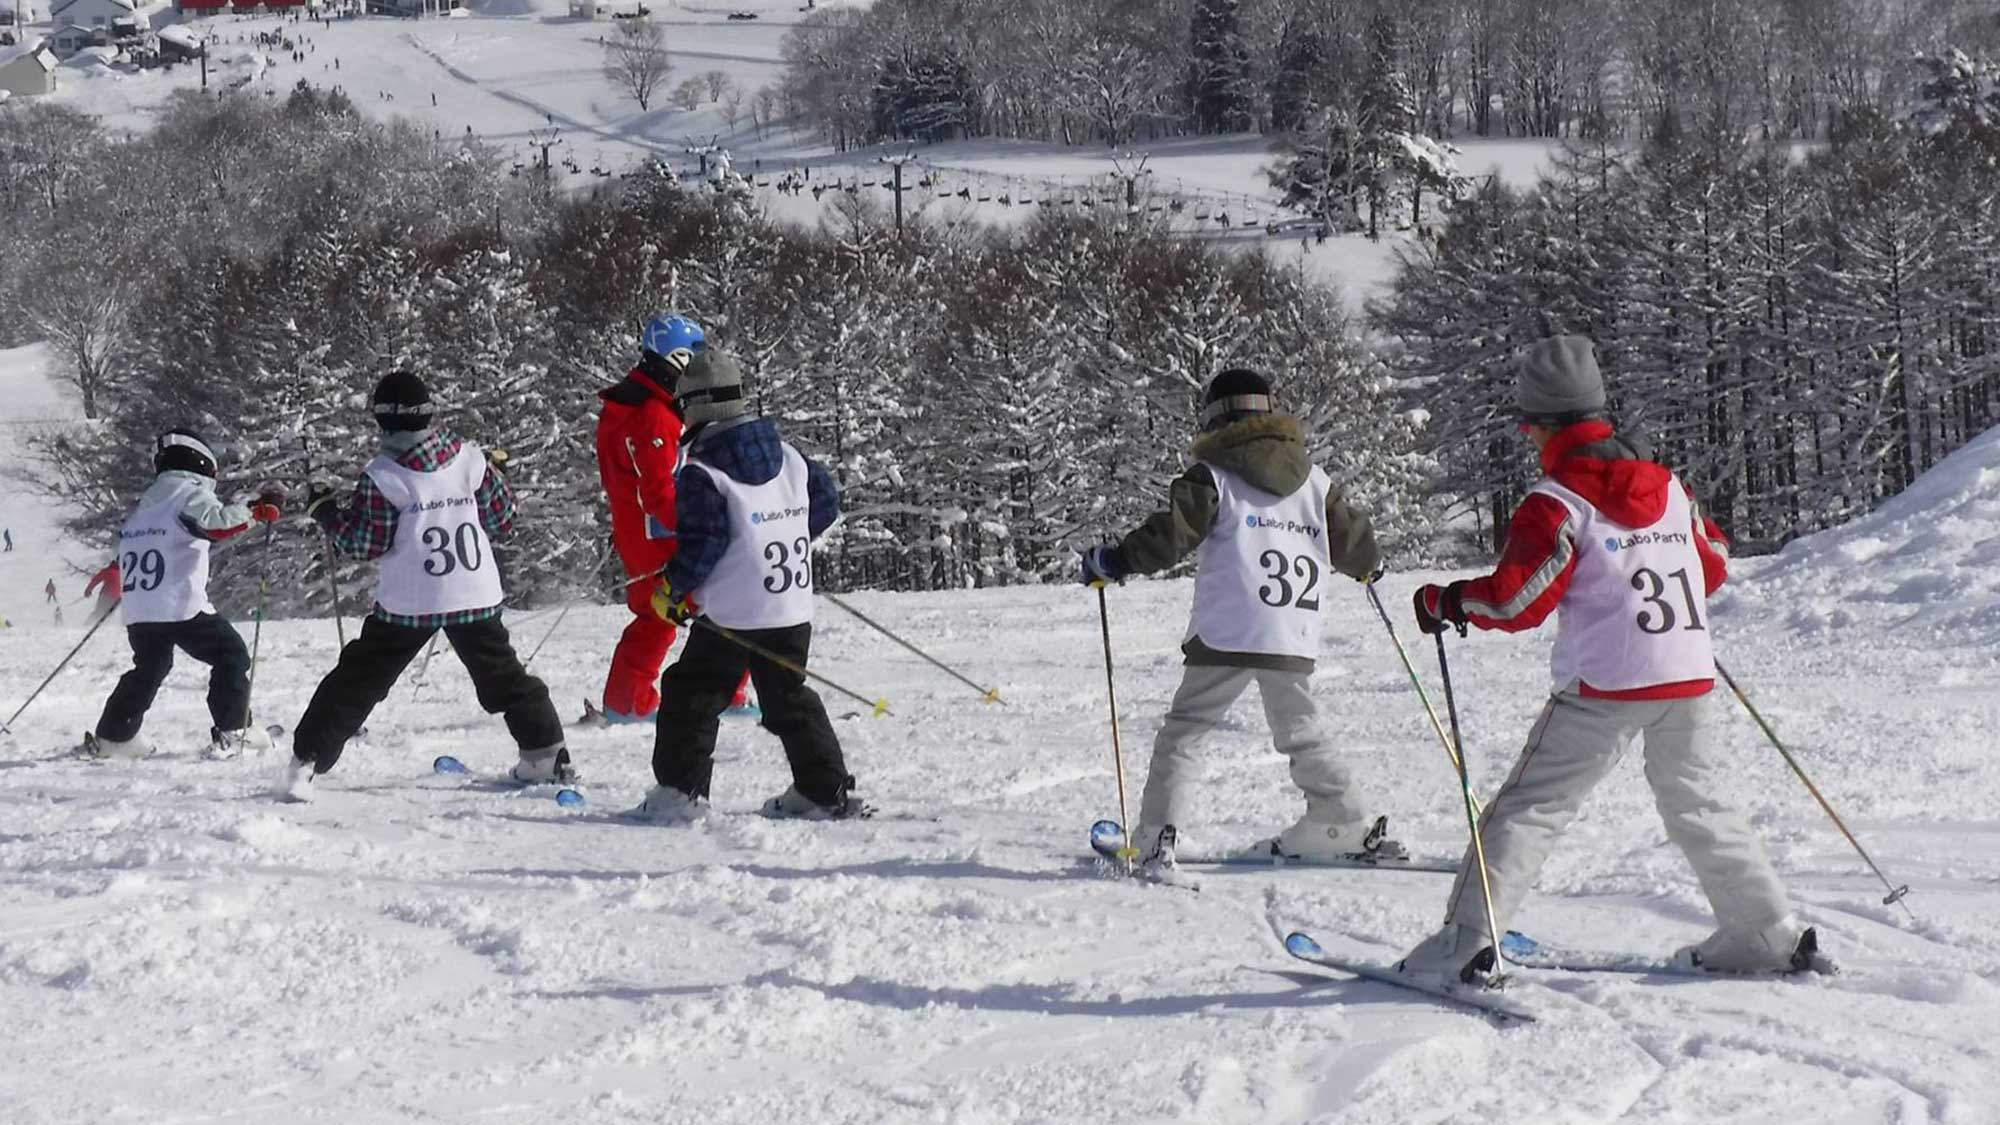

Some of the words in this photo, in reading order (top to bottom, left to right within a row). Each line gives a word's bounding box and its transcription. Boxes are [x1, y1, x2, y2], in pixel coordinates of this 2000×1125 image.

[420, 500, 445, 511] Labo
[1258, 516, 1285, 530] Labo
[1288, 520, 1320, 538] Party
[422, 522, 482, 576] 30
[764, 536, 810, 594] 33
[1618, 533, 1651, 550] Labo
[1652, 532, 1686, 544] Party
[122, 548, 166, 592] 29
[1259, 549, 1319, 612] 32
[1630, 568, 1705, 634] 31
